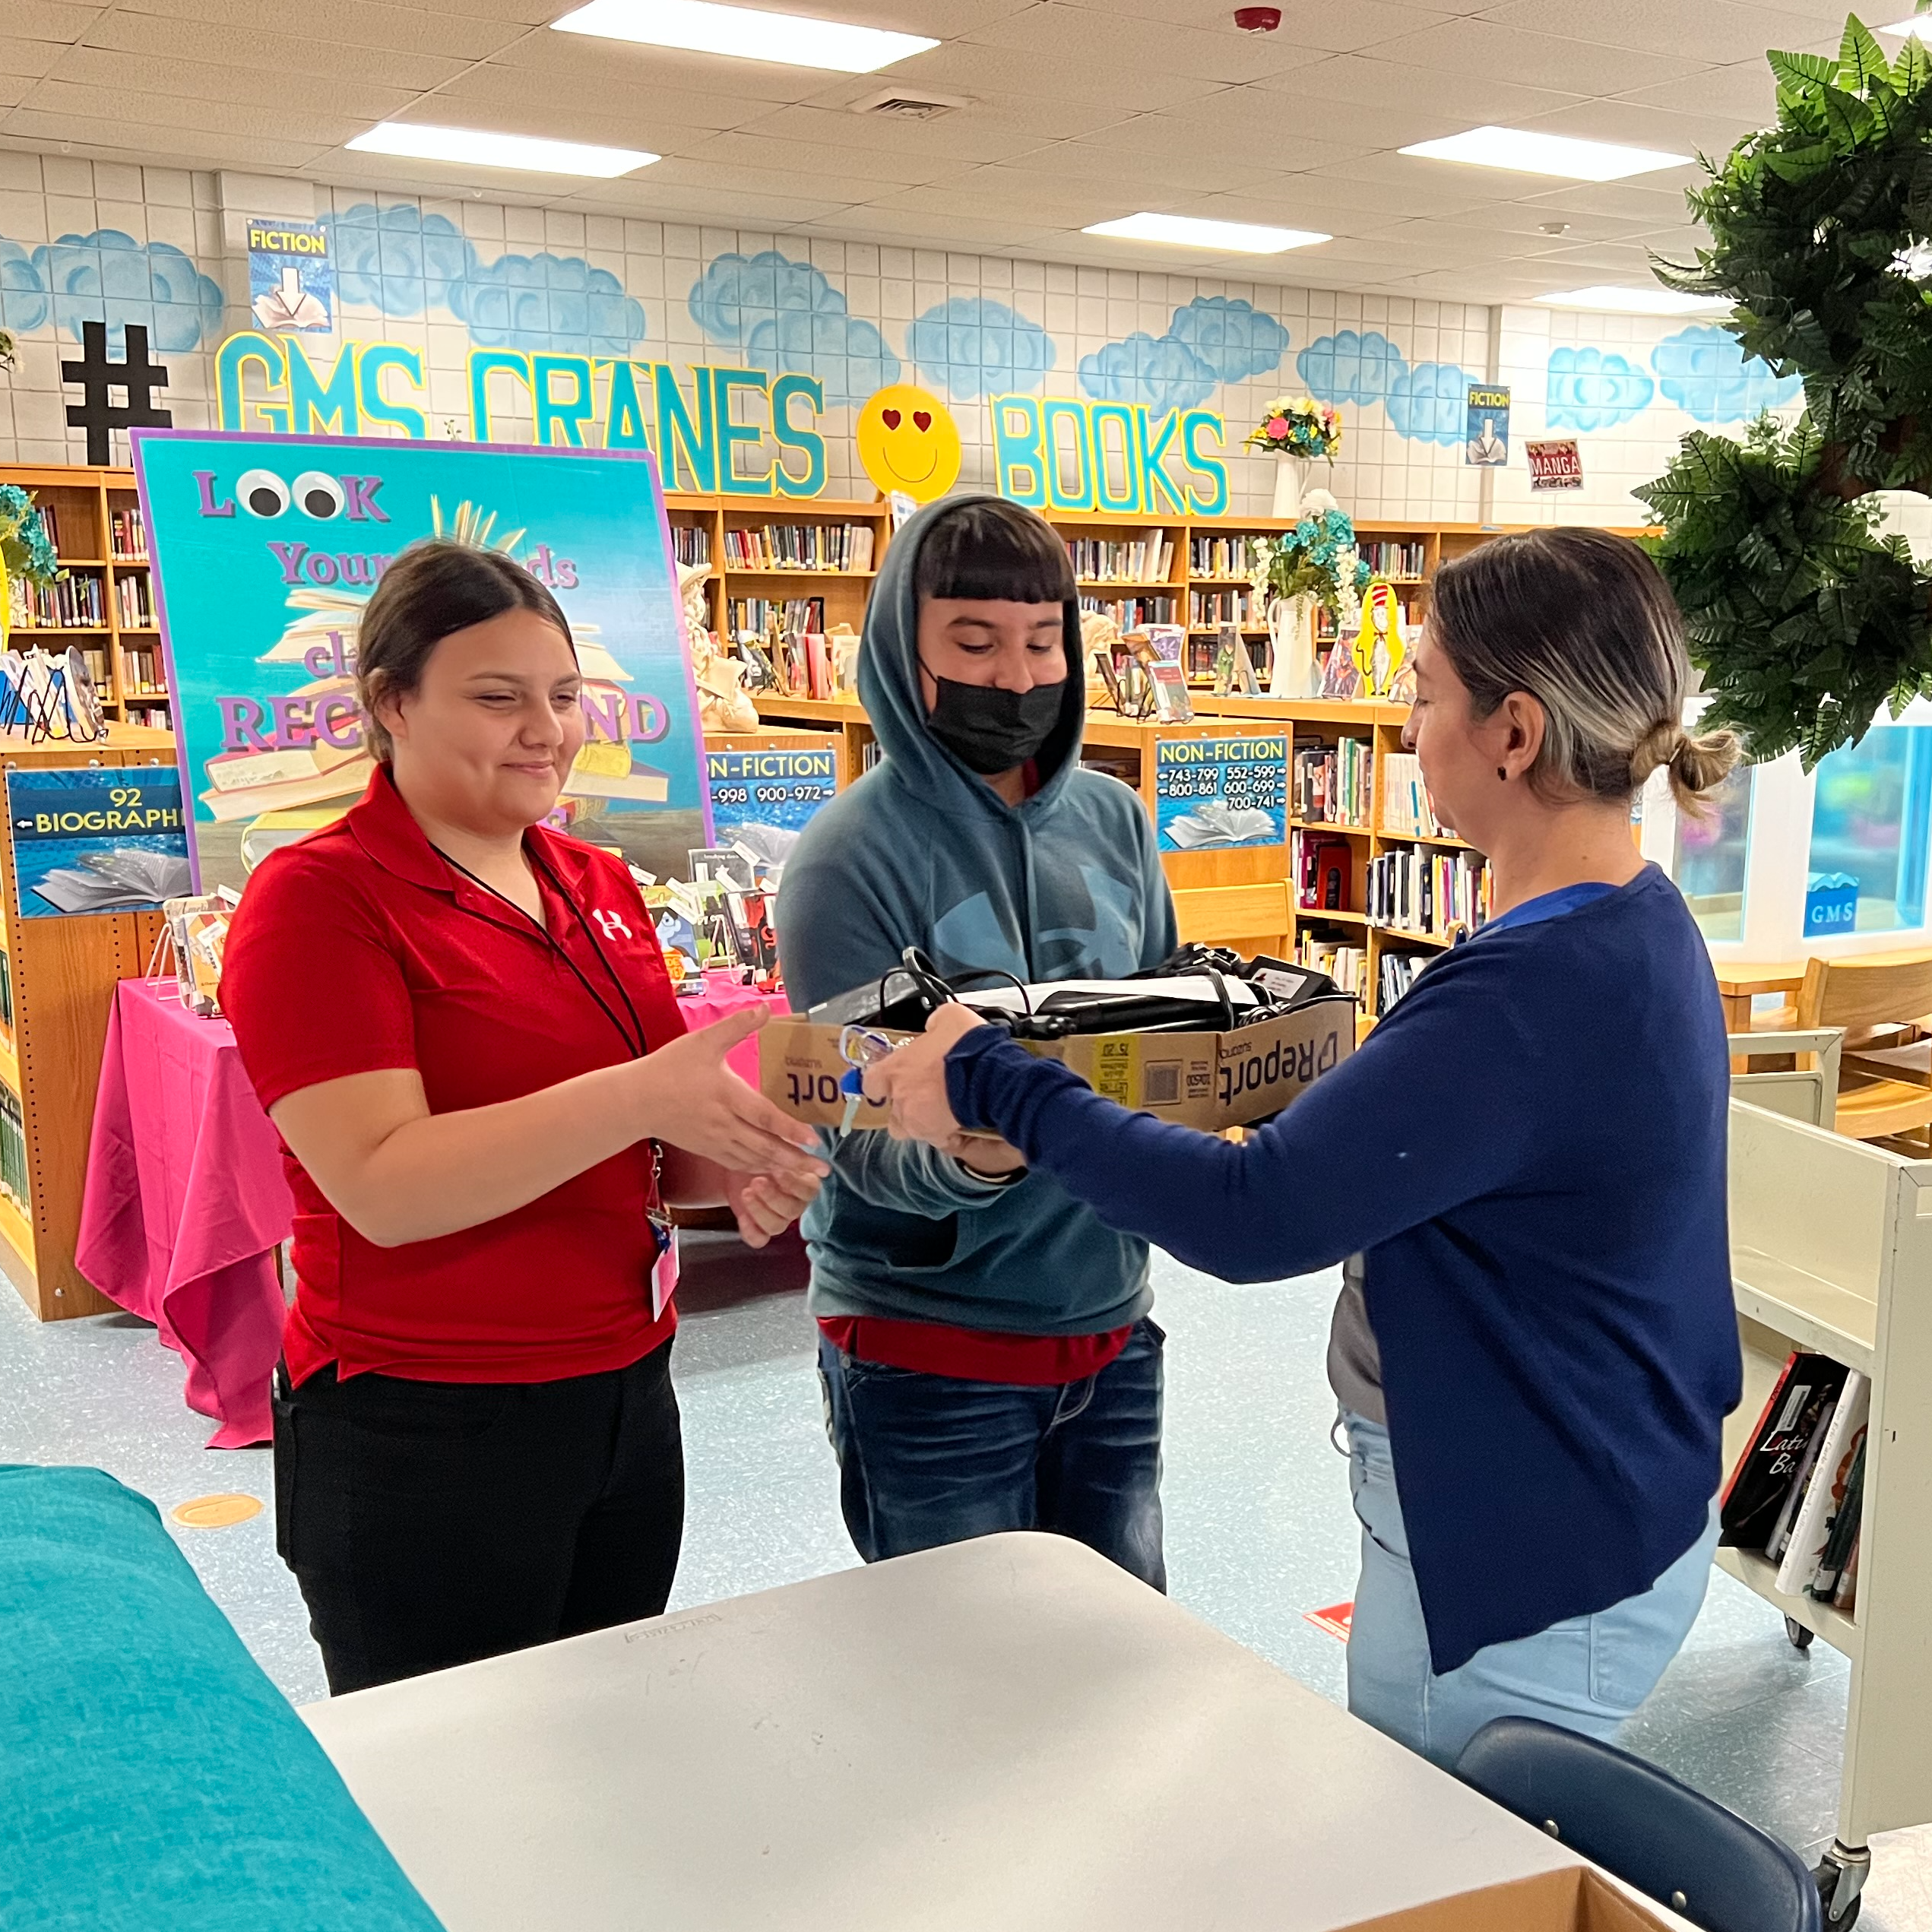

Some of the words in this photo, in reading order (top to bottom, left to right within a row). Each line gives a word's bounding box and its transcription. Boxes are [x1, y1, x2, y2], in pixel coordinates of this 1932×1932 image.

[250, 230, 326, 255] FICTION
[1469, 391, 1509, 407] FICTION
[215, 331, 427, 441] GMS
[467, 346, 828, 499] CRANES
[990, 393, 1231, 516] BOOKS
[1530, 456, 1581, 475] MANGA
[1161, 741, 1284, 763] NON-FICTION
[707, 755, 830, 778] N-FICTION
[1168, 768, 1219, 782] 743-799
[1227, 765, 1276, 780] 552-599
[109, 788, 143, 807] 92
[756, 786, 822, 802] 900-972
[1169, 781, 1218, 797] 800-861
[1224, 780, 1275, 794] 600-699
[1228, 795, 1275, 809] 700-741
[36, 809, 185, 833] BIOGRAPHI
[1811, 901, 1854, 924] GMS
[1219, 1039, 1315, 1107] Report
[1760, 1430, 1810, 1452] Lati
[1769, 1452, 1796, 1474] Ba
